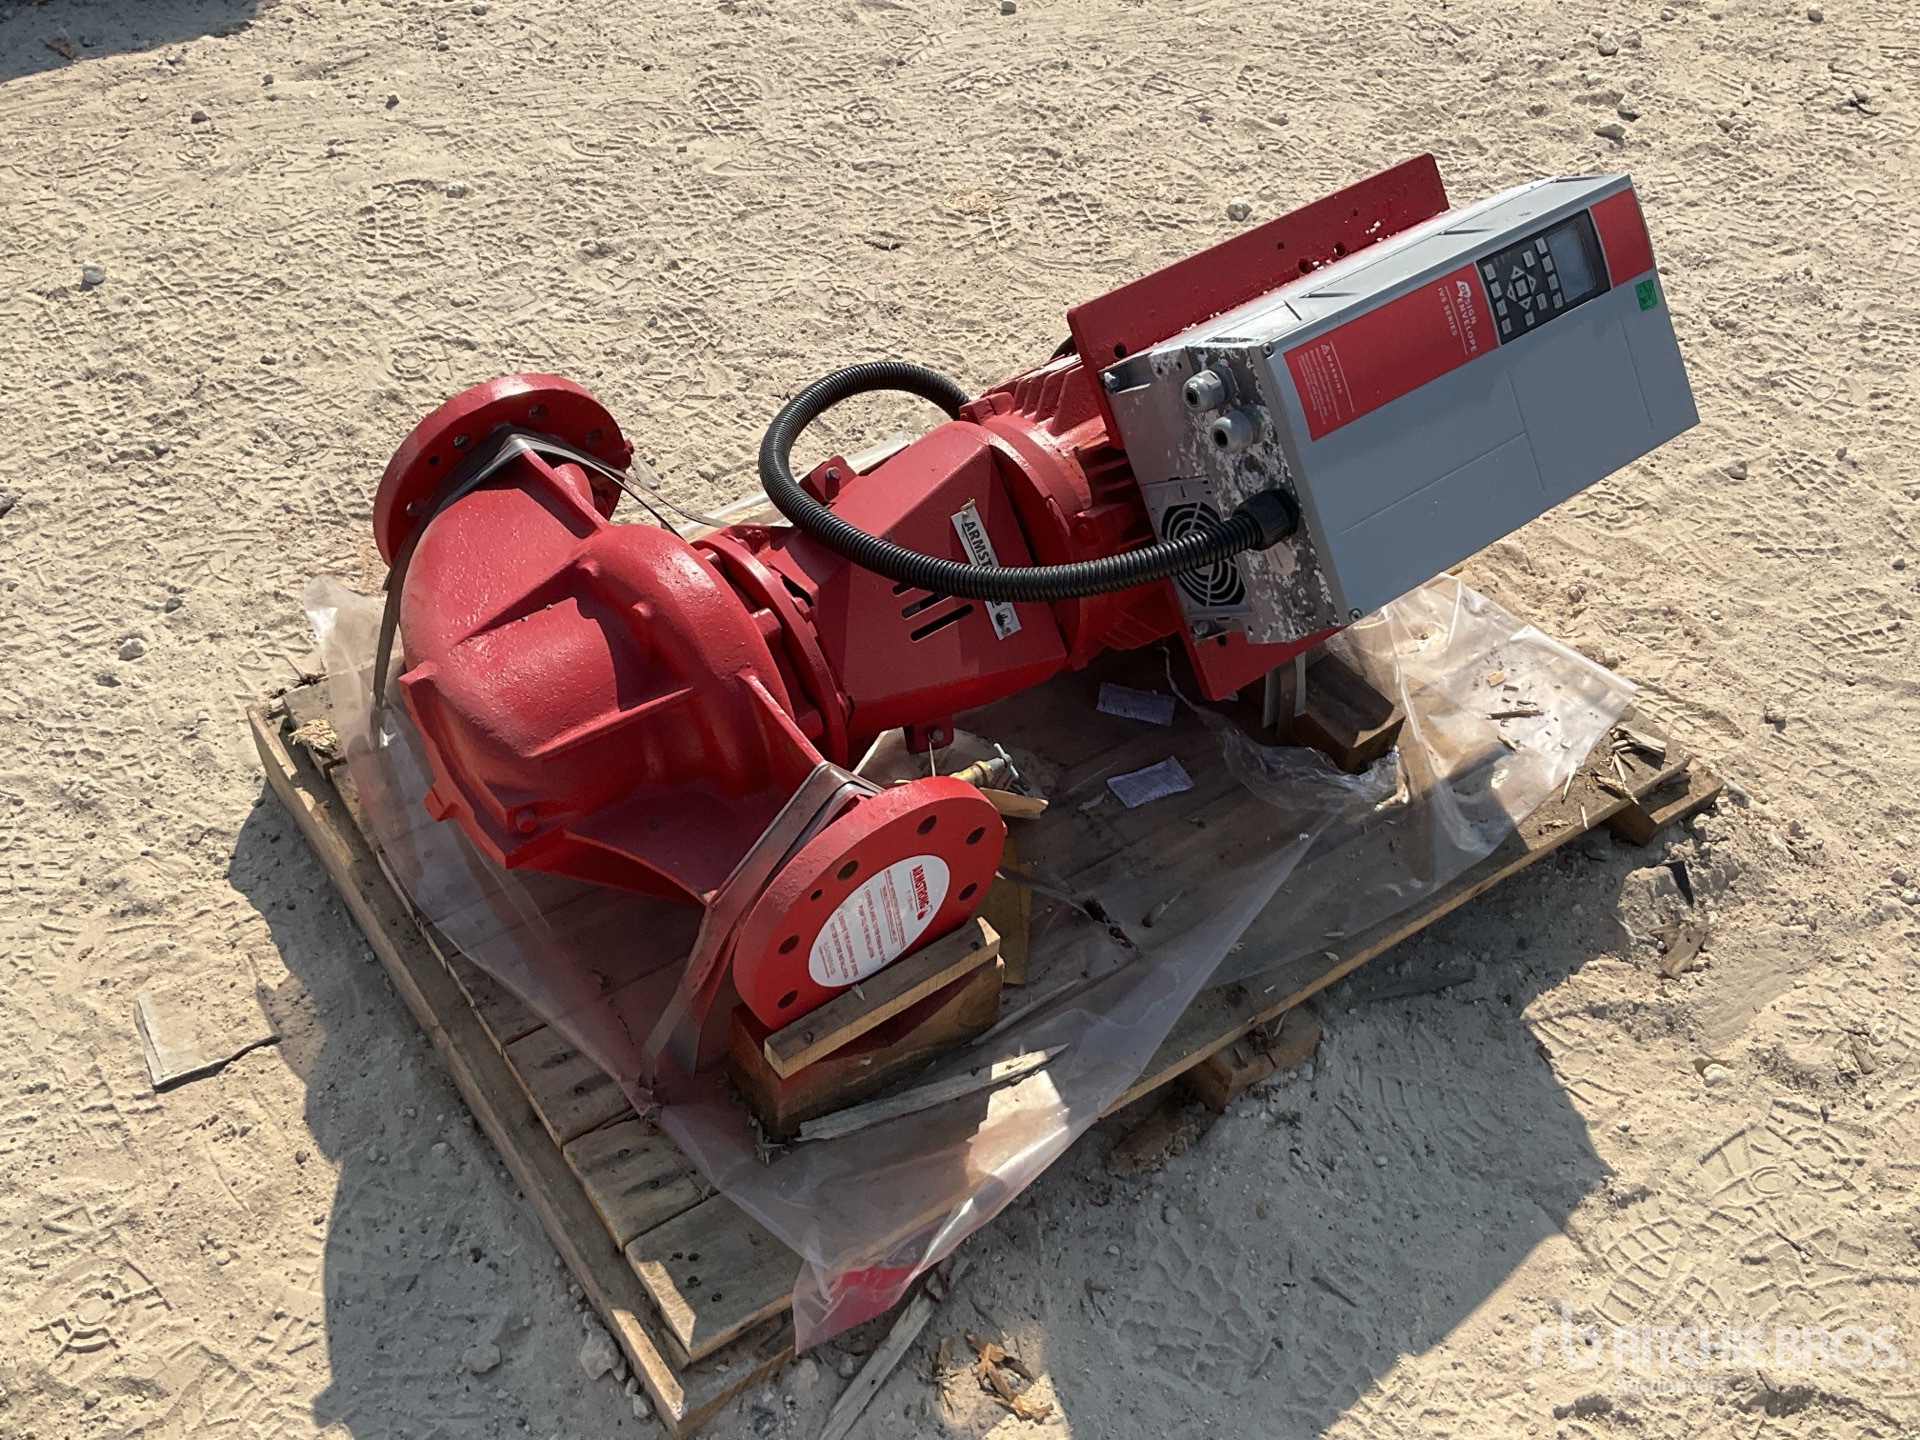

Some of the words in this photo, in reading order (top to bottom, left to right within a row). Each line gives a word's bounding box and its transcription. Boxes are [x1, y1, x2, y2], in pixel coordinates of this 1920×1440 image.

[1443, 304, 1458, 336] SERIES
[1456, 297, 1477, 352] ENVELOPE
[1459, 283, 1477, 325] DESIGN
[1326, 354, 1343, 394] WARNING
[911, 864, 930, 910] ARMSTRONG
